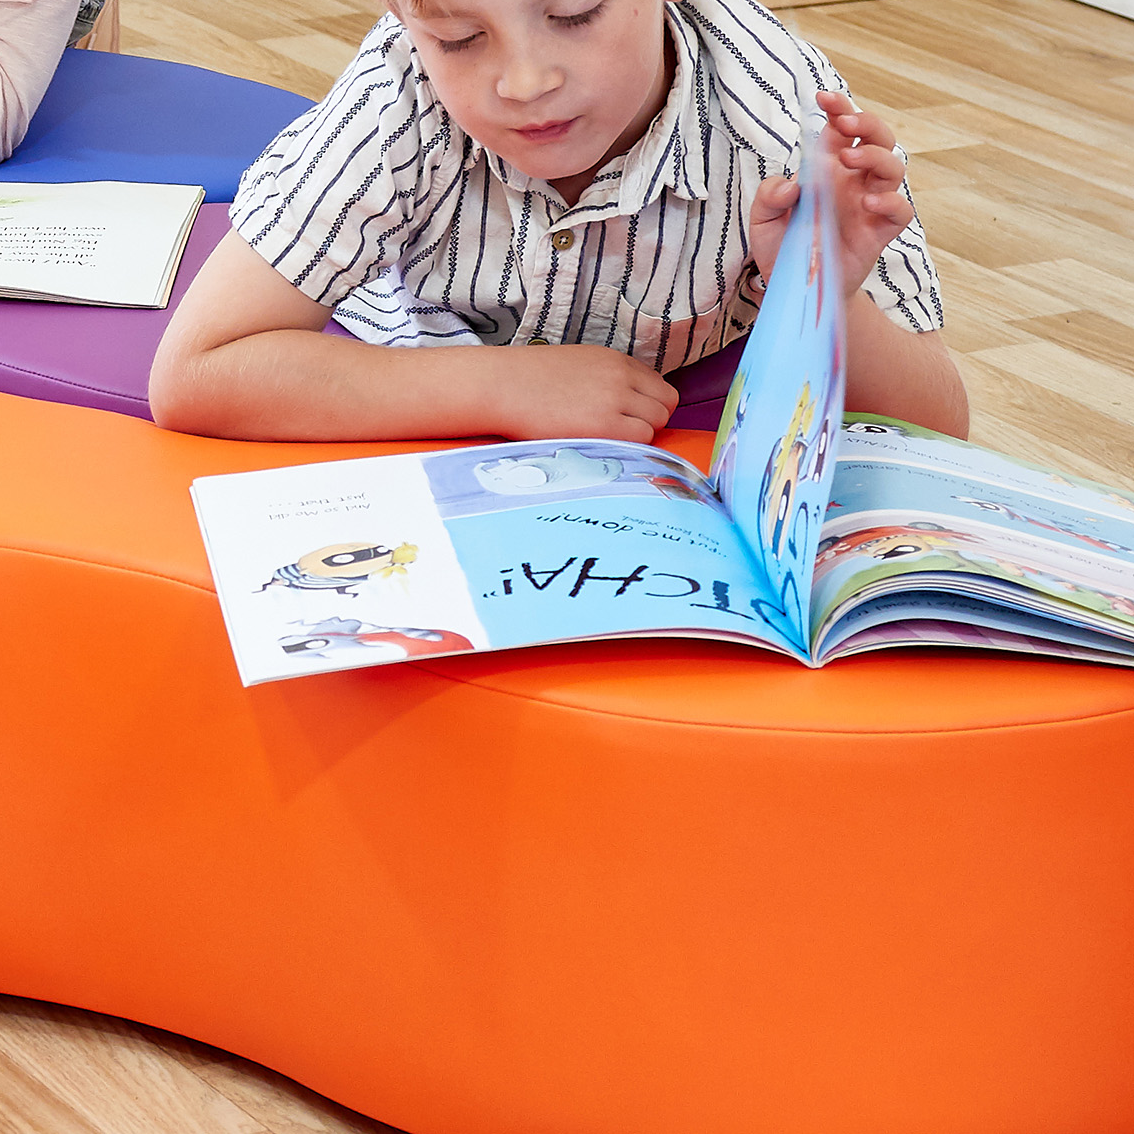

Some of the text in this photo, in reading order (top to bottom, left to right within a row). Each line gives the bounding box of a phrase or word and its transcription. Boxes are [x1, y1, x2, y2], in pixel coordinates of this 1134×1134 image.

[843, 436, 898, 451] REALLY
[300, 498, 330, 507] that
[340, 491, 366, 502] just
[346, 503, 371, 512] And
[268, 513, 290, 521] did
[536, 511, 632, 534] down!"
[642, 529, 682, 543] me
[665, 524, 693, 537] Ron
